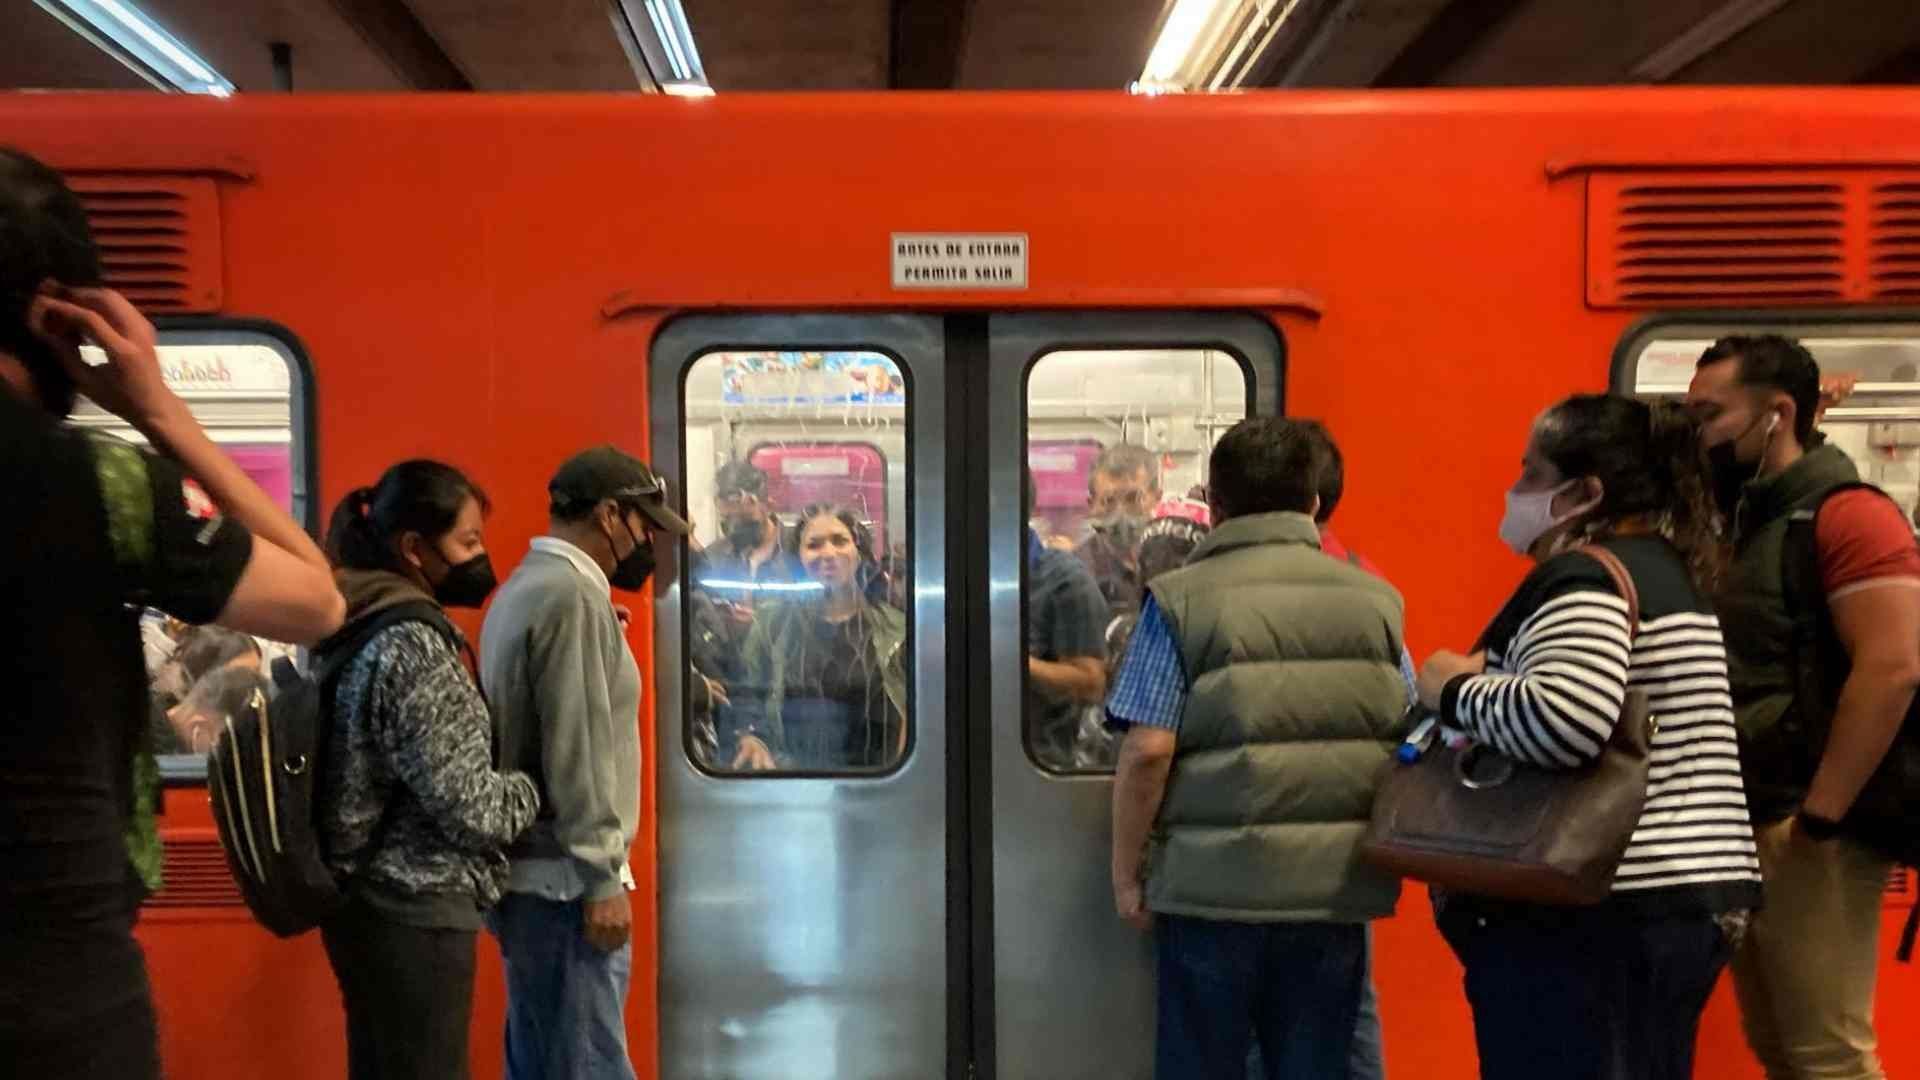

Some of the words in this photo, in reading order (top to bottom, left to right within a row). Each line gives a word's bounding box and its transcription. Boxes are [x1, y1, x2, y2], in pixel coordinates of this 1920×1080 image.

[898, 243, 939, 256] ANTES
[946, 243, 961, 256] DE
[968, 243, 1020, 256] ENTRAR
[905, 266, 967, 281] PERMITA
[975, 266, 1013, 280] SALIR
